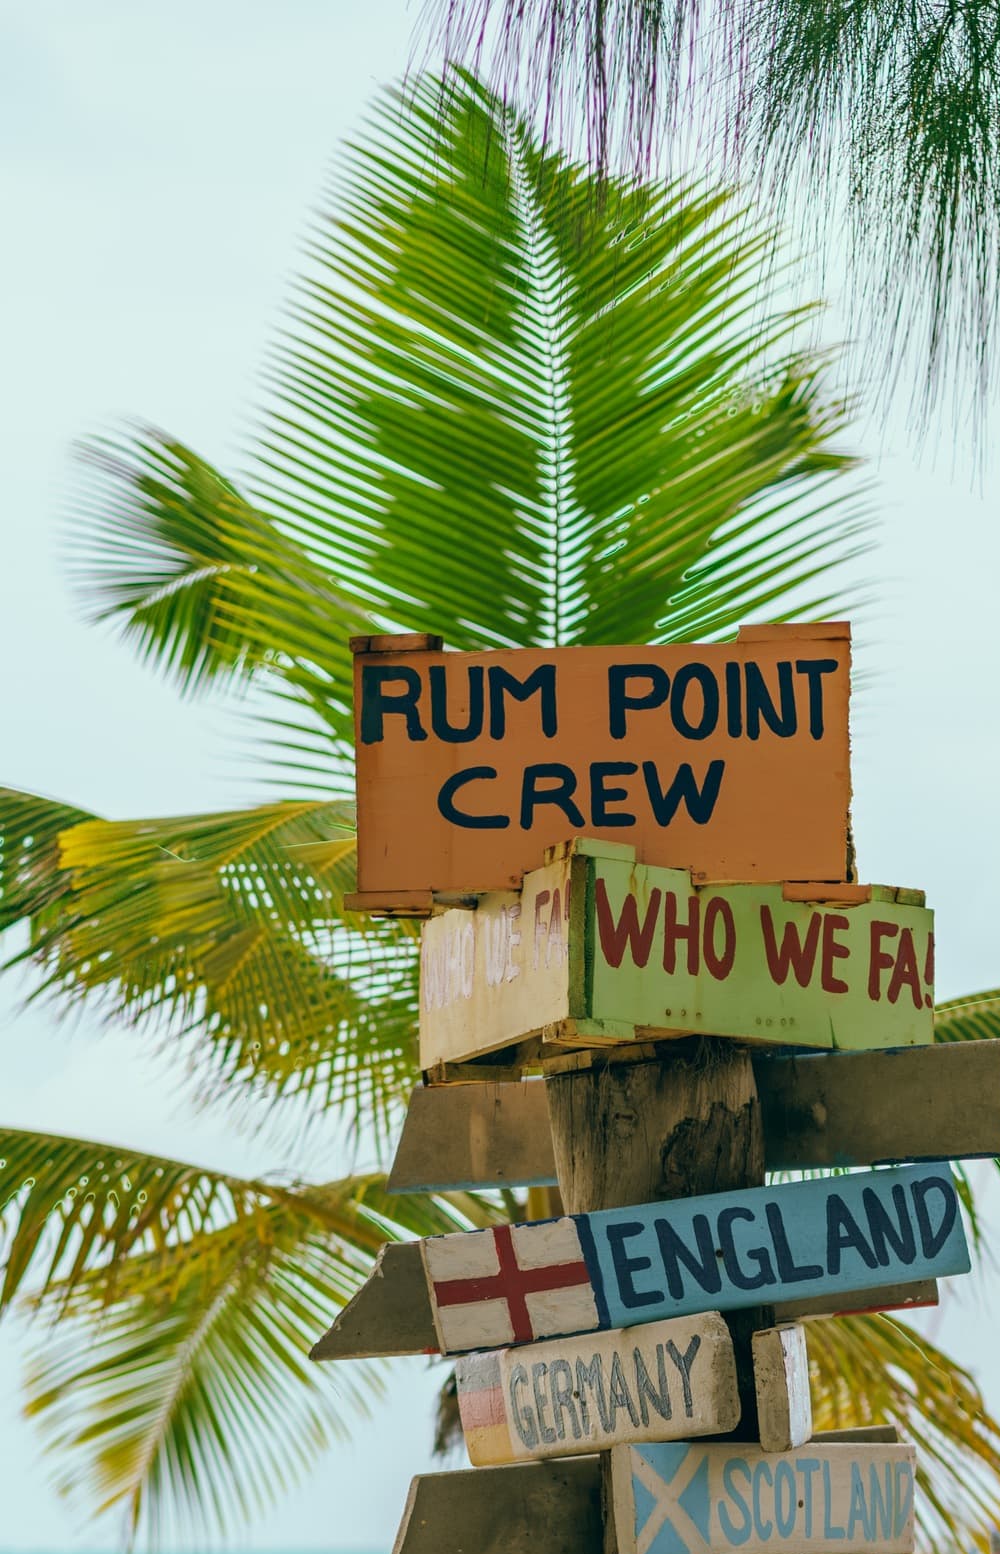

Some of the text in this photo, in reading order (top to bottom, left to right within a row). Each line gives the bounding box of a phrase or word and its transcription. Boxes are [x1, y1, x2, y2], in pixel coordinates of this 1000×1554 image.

[361, 658, 839, 744] RUM POINT
[437, 759, 725, 830] CREW
[485, 904, 522, 988] WE
[594, 877, 934, 1010] WHO WE FA!
[606, 1176, 958, 1310] ENGLAND
[510, 1334, 701, 1449] GERMANY
[717, 1457, 914, 1546] SCOTLAND
